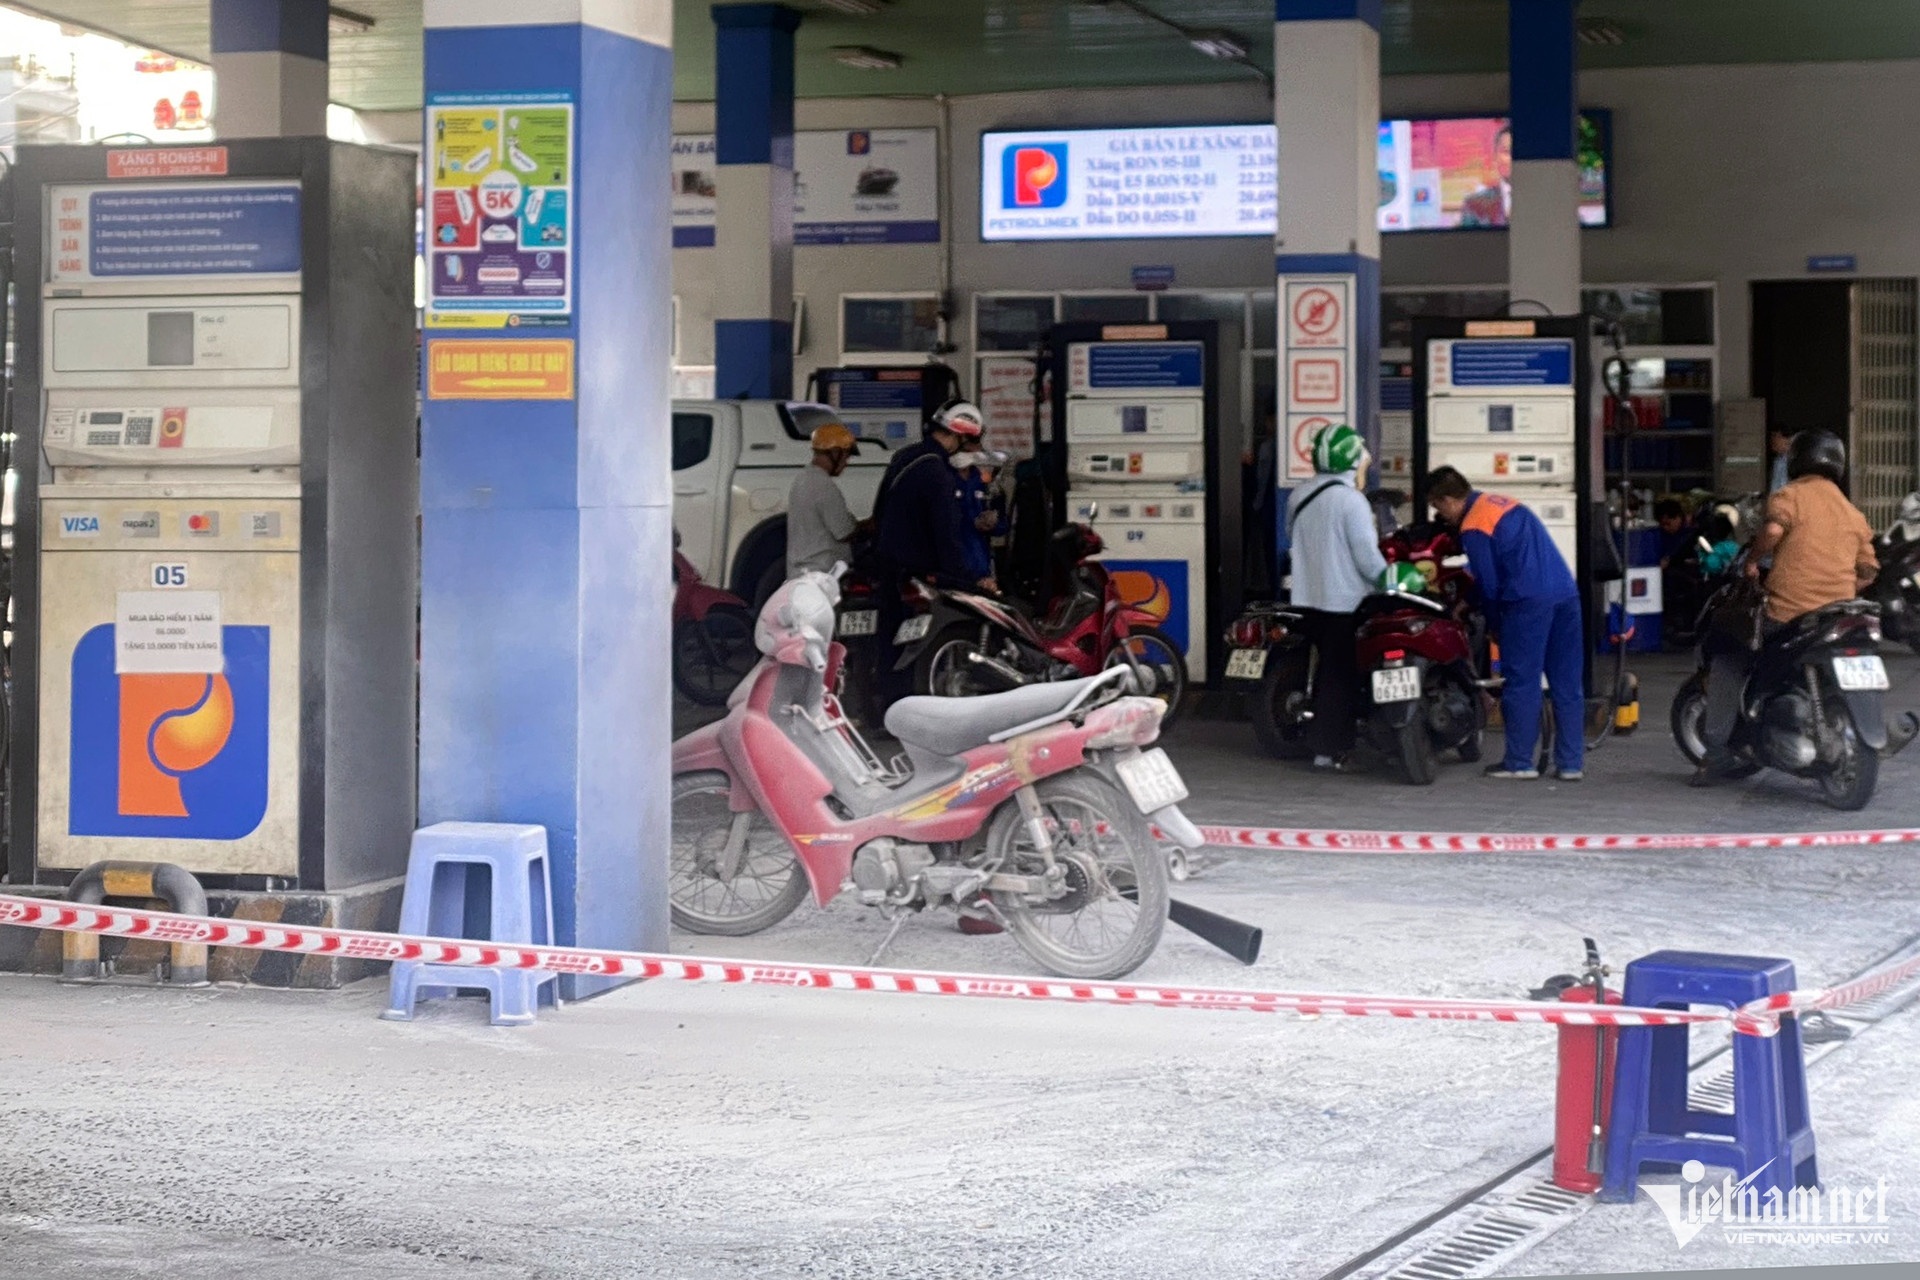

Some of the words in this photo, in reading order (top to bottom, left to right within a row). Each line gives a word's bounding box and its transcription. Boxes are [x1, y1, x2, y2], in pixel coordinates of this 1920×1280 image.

[486, 191, 513, 209] 5K
[989, 217, 1080, 229] PETROLIMEX
[63, 517, 99, 532] VISA
[154, 565, 185, 586] 05
